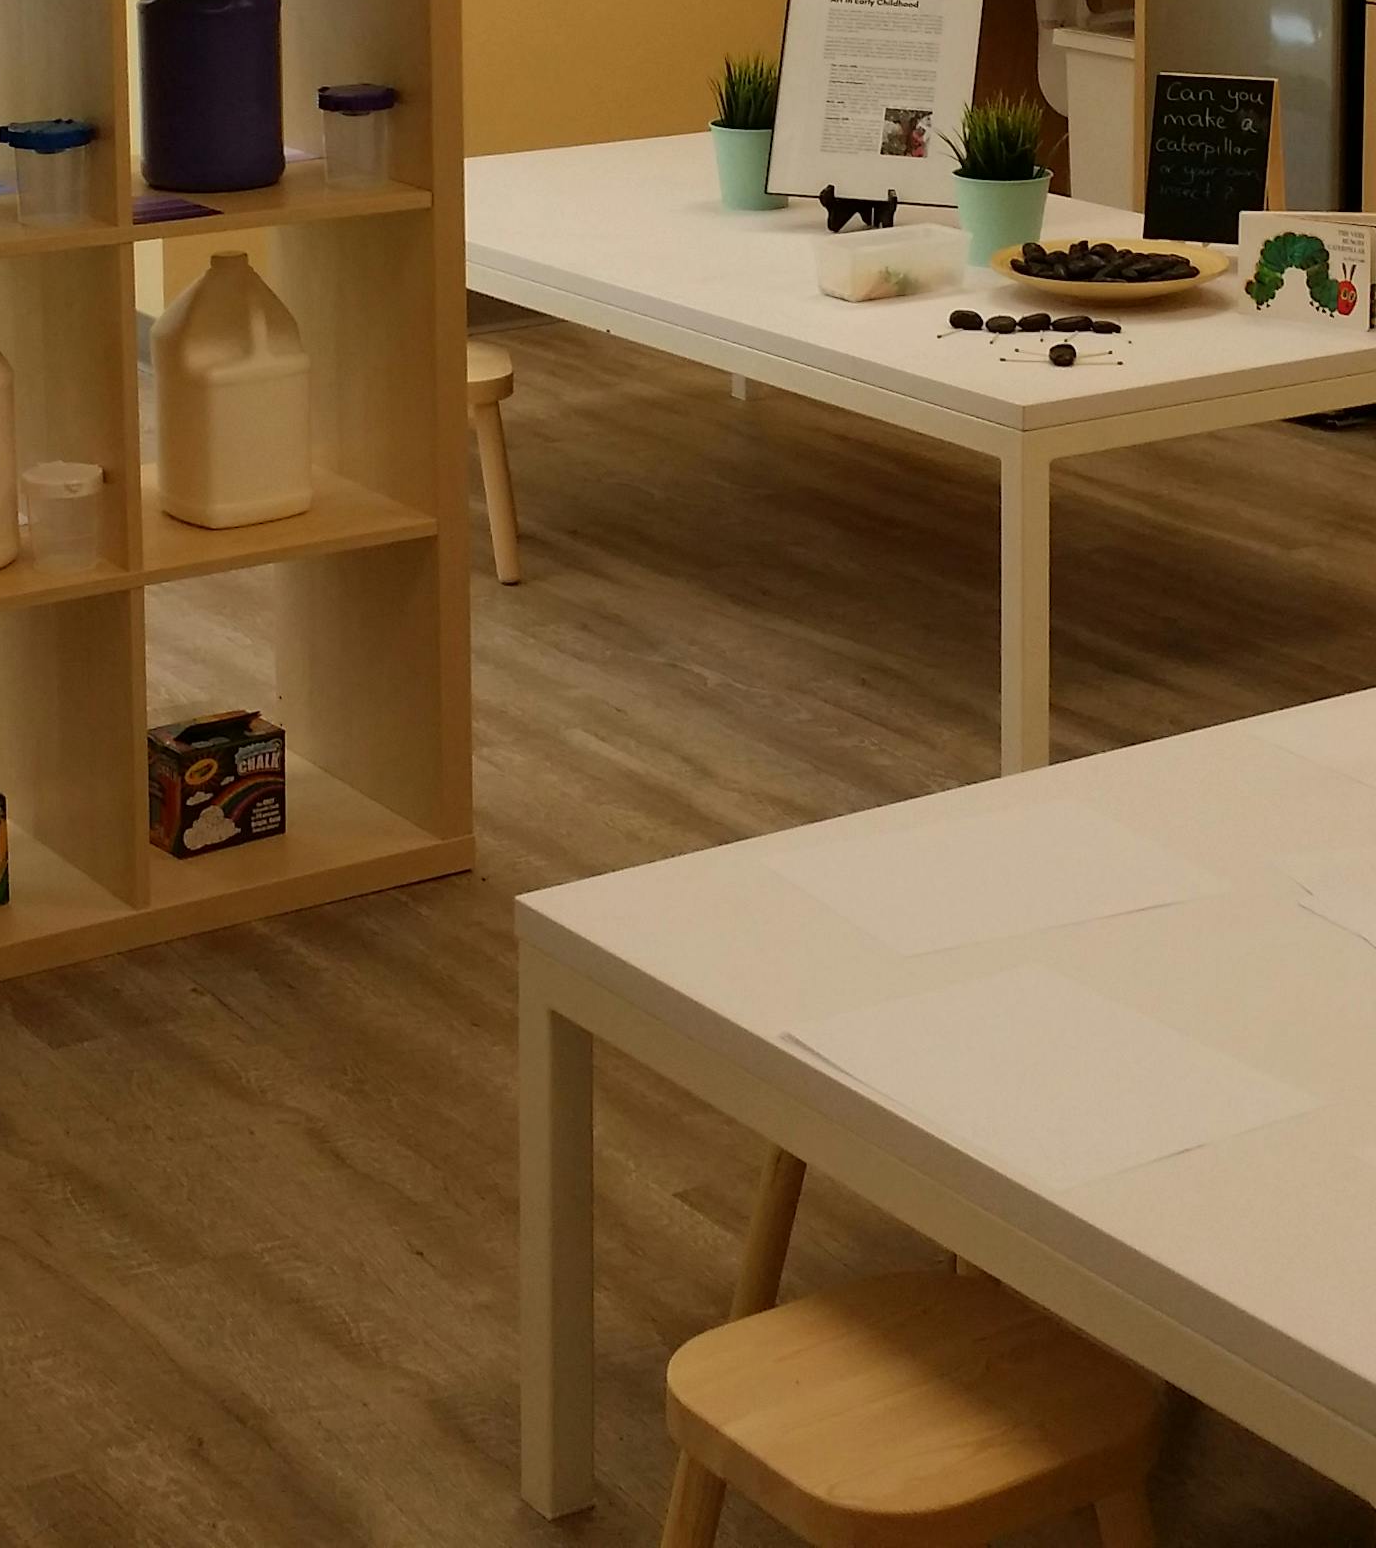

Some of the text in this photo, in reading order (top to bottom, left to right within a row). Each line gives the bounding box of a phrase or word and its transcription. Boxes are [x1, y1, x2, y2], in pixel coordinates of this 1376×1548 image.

[876, 0, 919, 9] Childhood
[1166, 81, 1265, 114] Can you
[1163, 107, 1258, 134] make a
[237, 751, 281, 775] CHALK
